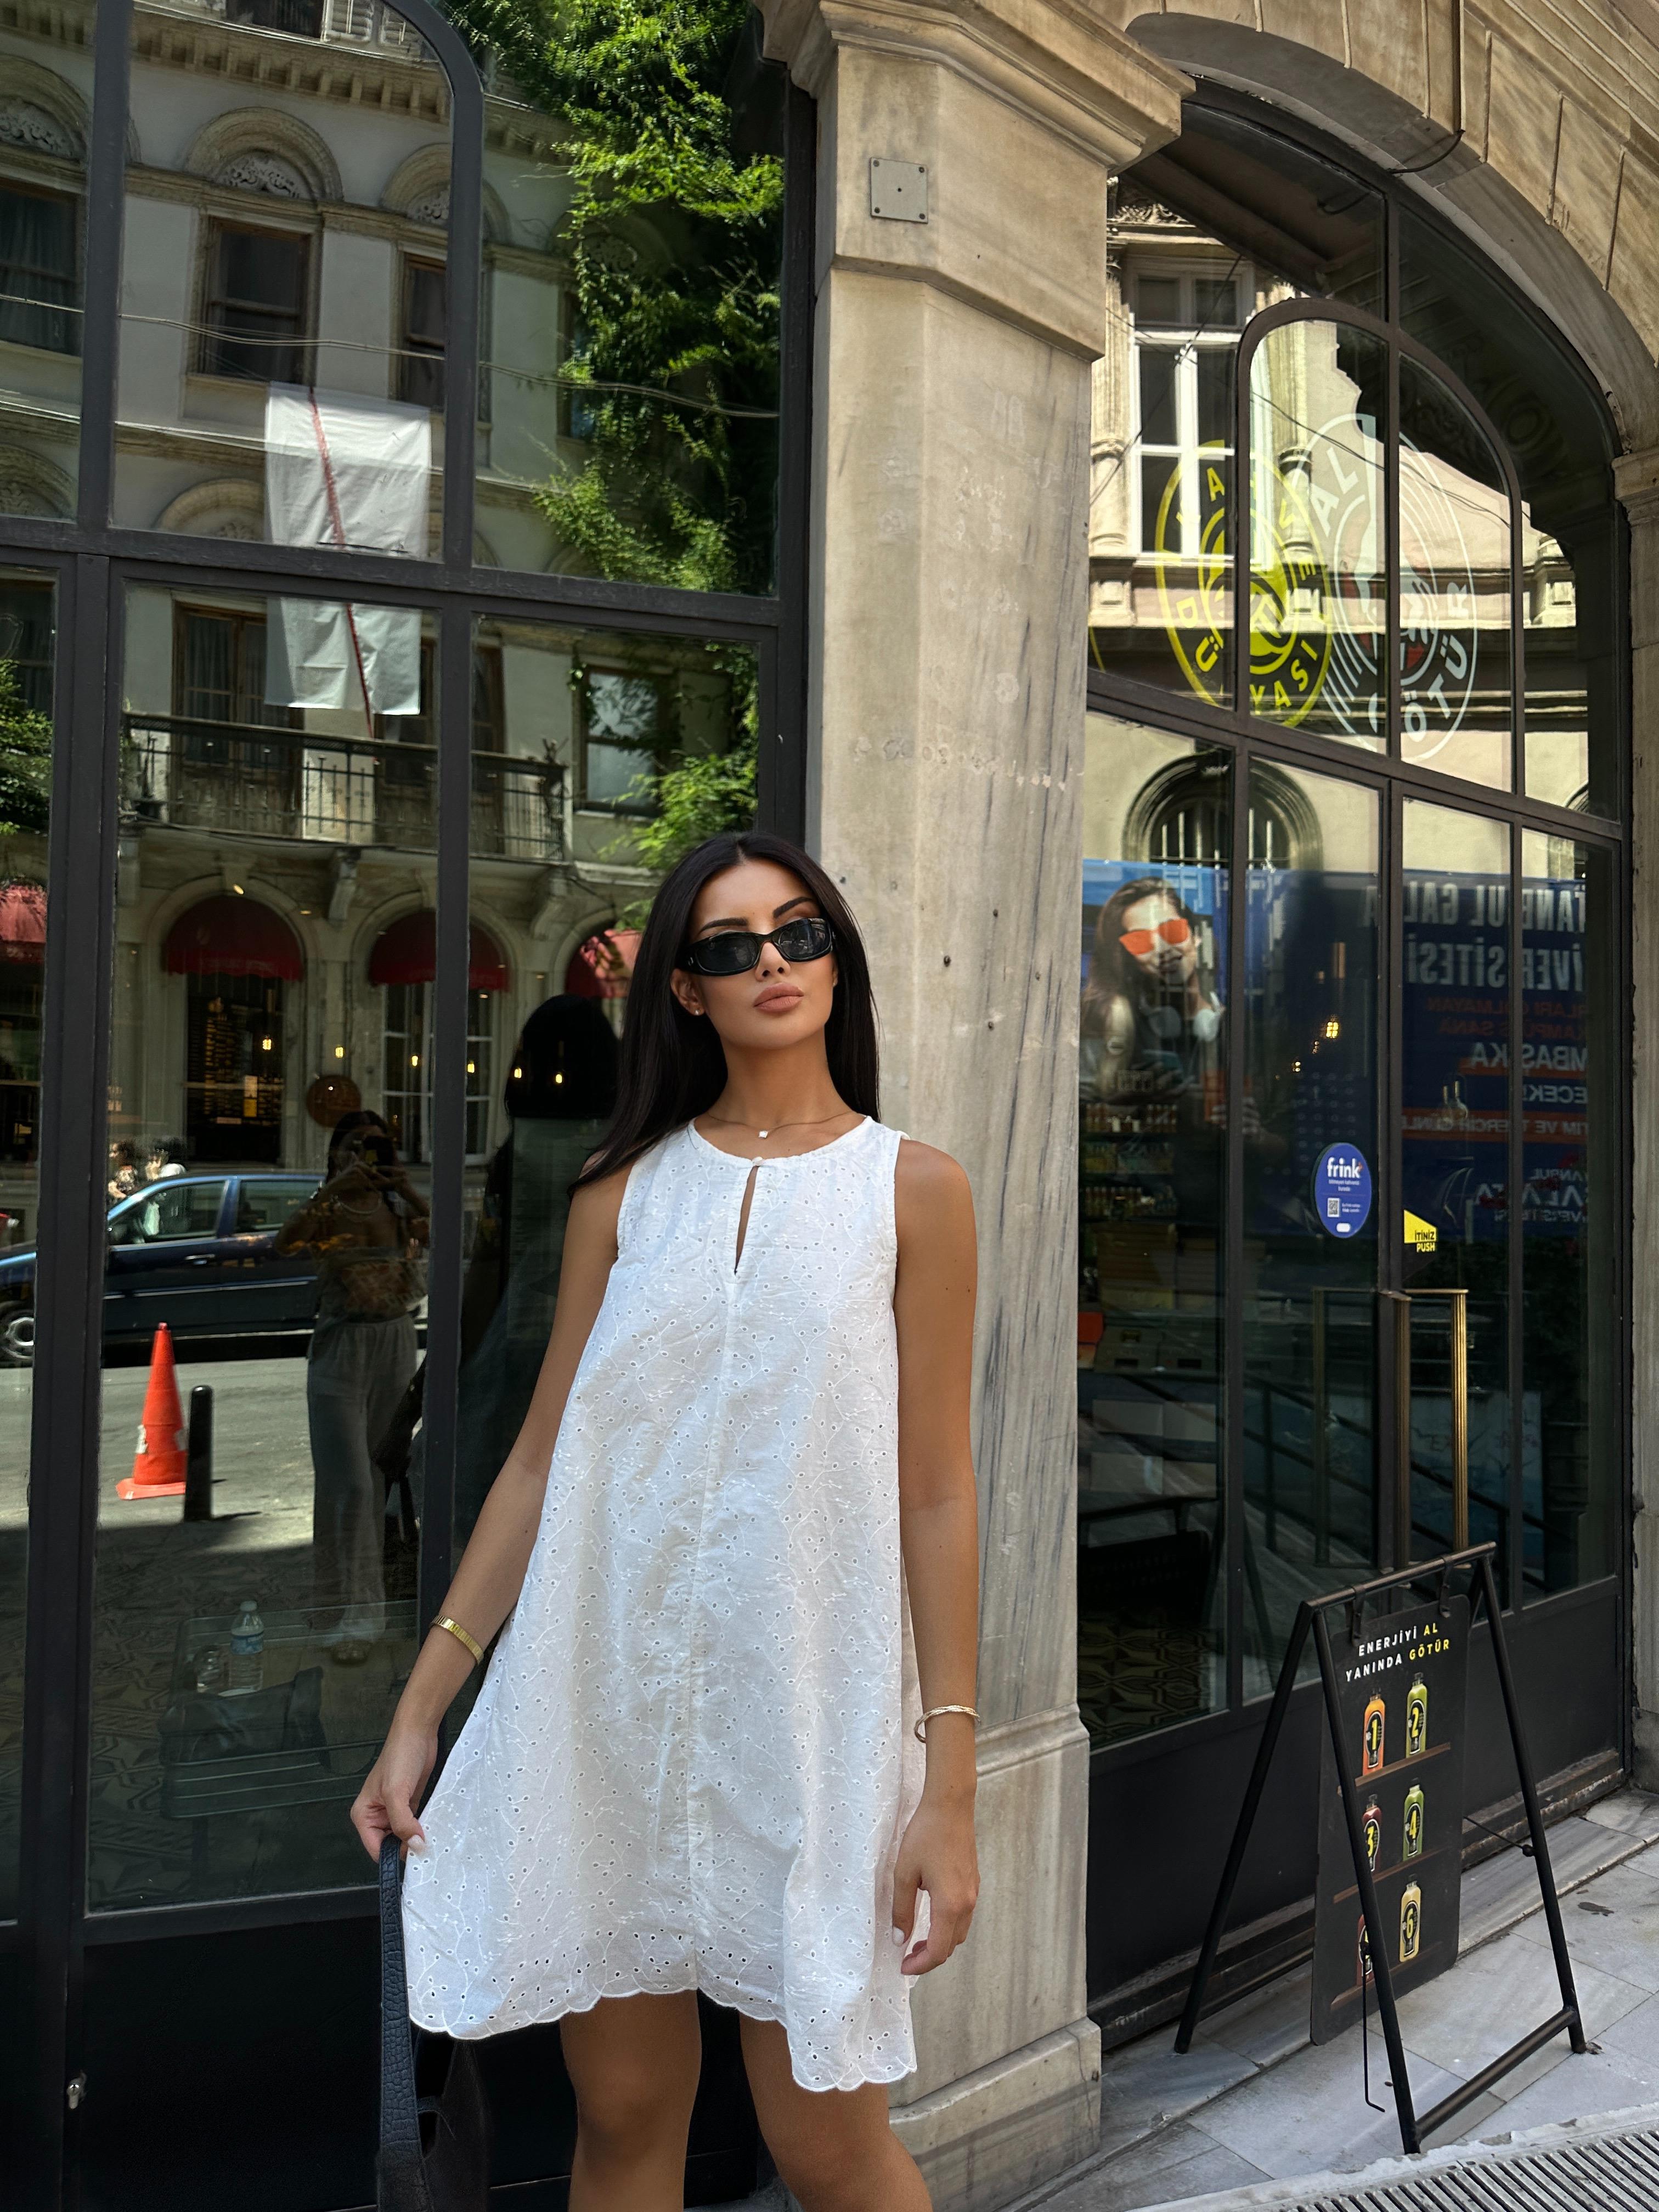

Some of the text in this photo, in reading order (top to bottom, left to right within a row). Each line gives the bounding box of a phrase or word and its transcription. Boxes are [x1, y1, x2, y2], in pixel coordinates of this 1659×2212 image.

[1177, 596, 1319, 715] DÜYASI
[1327, 1155, 1361, 1178] frink
[1417, 1242, 1436, 1253] PUSH
[1358, 1622, 1438, 1657] ENERJİYİ AL
[1345, 1639, 1450, 1682] YANINDA GÖTÜR
[1372, 1718, 1378, 1750] 1
[1412, 1707, 1419, 1738] 2
[1409, 1810, 1417, 1839] 4
[1367, 1826, 1374, 1858] 3
[1406, 1908, 1414, 1939] 6
